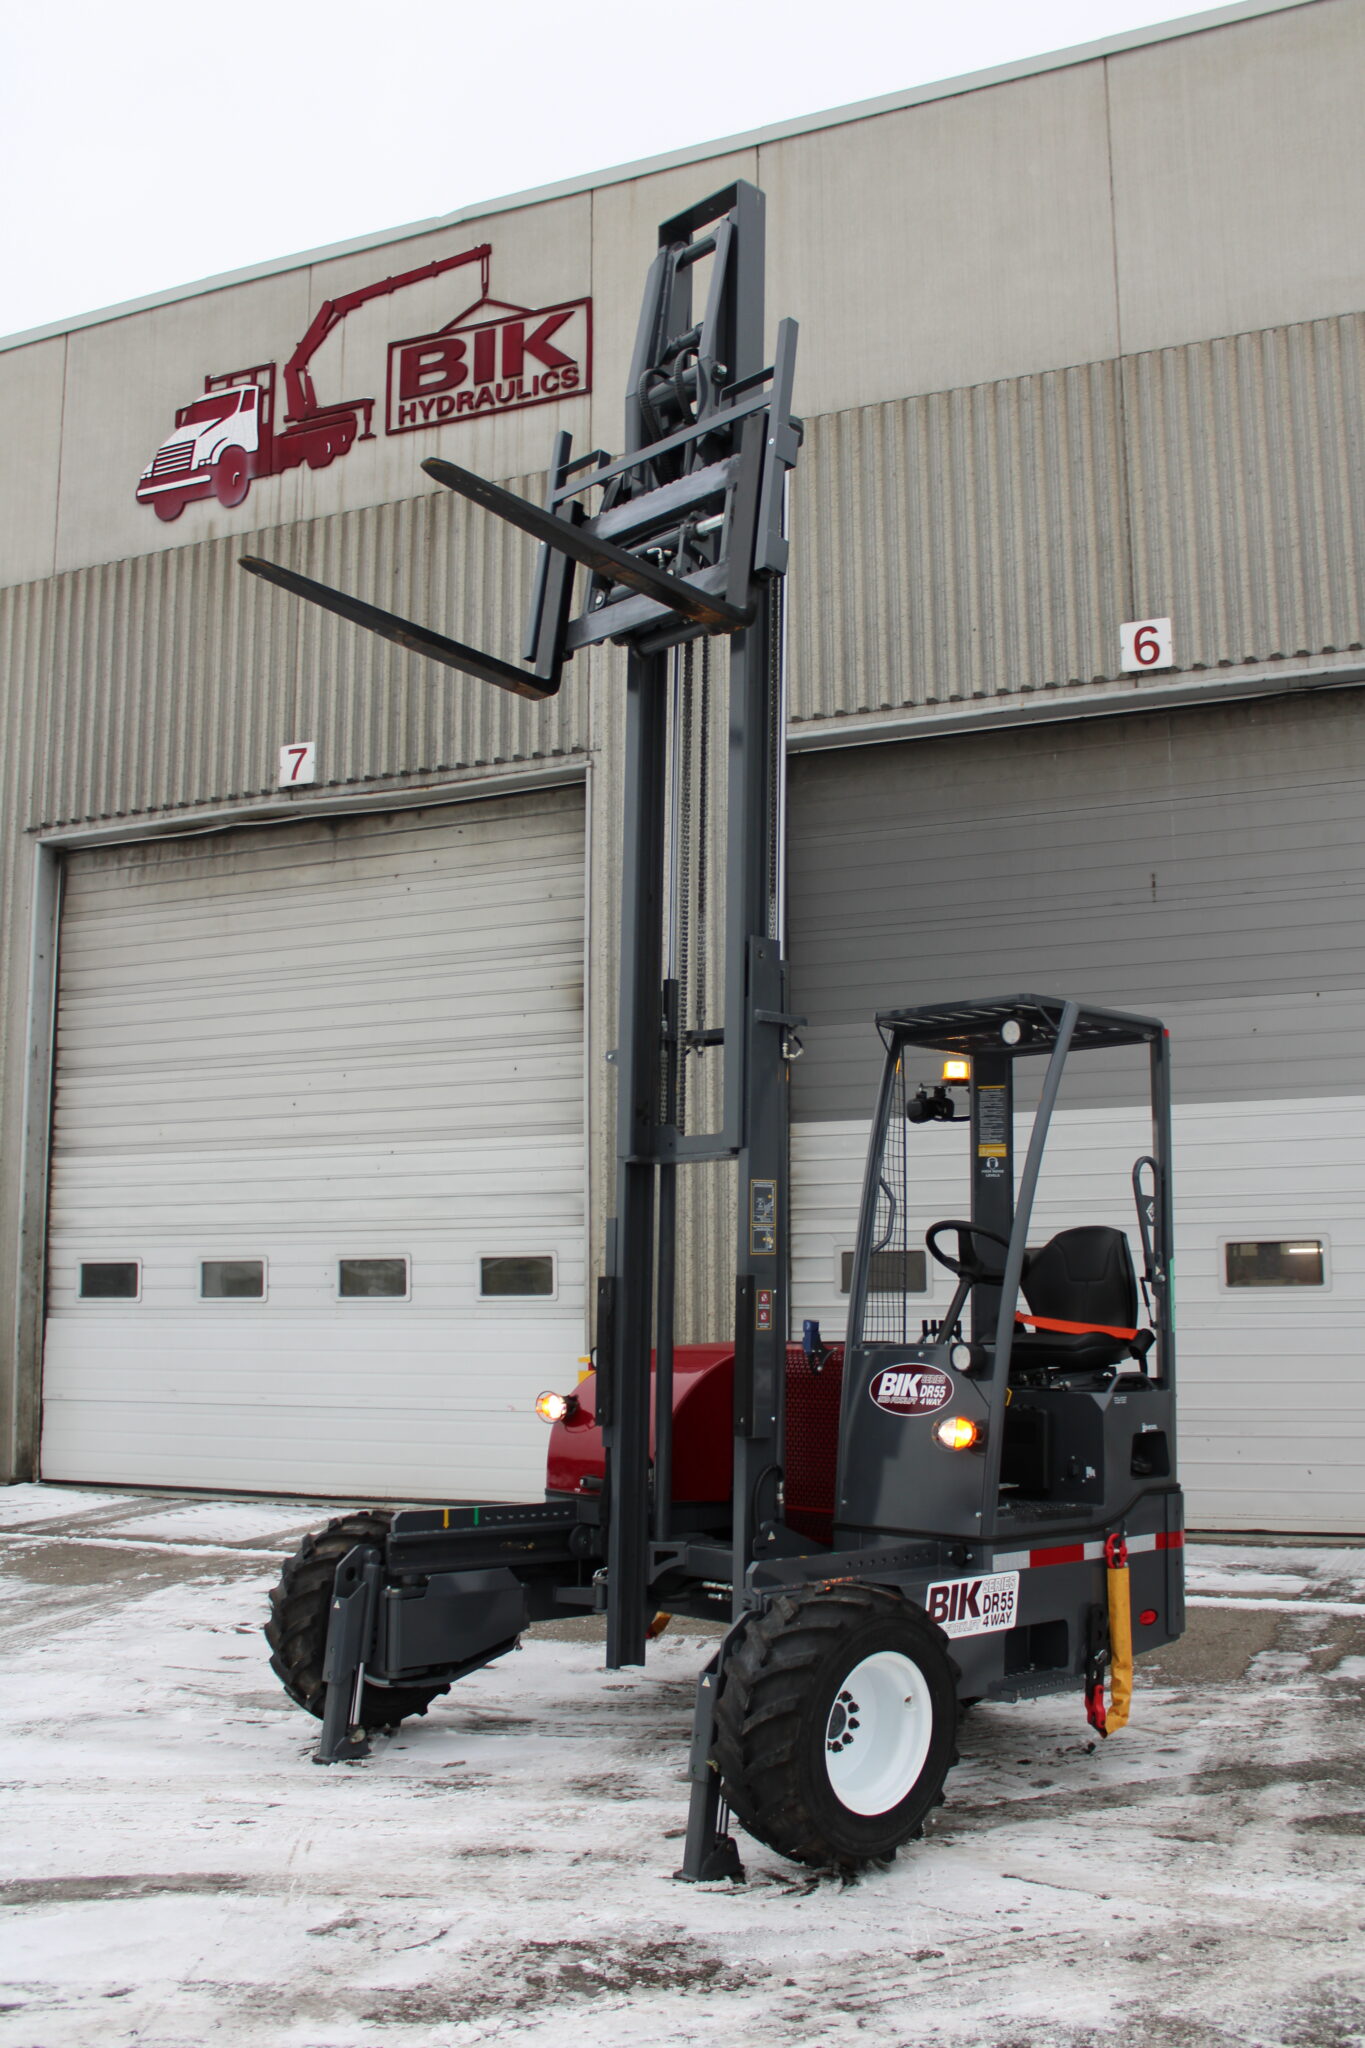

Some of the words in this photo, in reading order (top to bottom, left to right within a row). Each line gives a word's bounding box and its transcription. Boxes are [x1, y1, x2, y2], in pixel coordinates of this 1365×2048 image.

[399, 310, 578, 401] BIK
[398, 366, 580, 426] HYDRAULICS
[1133, 625, 1160, 665] 6
[288, 747, 308, 781] 7
[878, 1373, 922, 1397] BIK
[920, 1385, 946, 1398] DR55
[982, 1576, 1016, 1593] SERIES
[928, 1580, 983, 1625] BIK
[982, 1591, 1014, 1615] DR55
